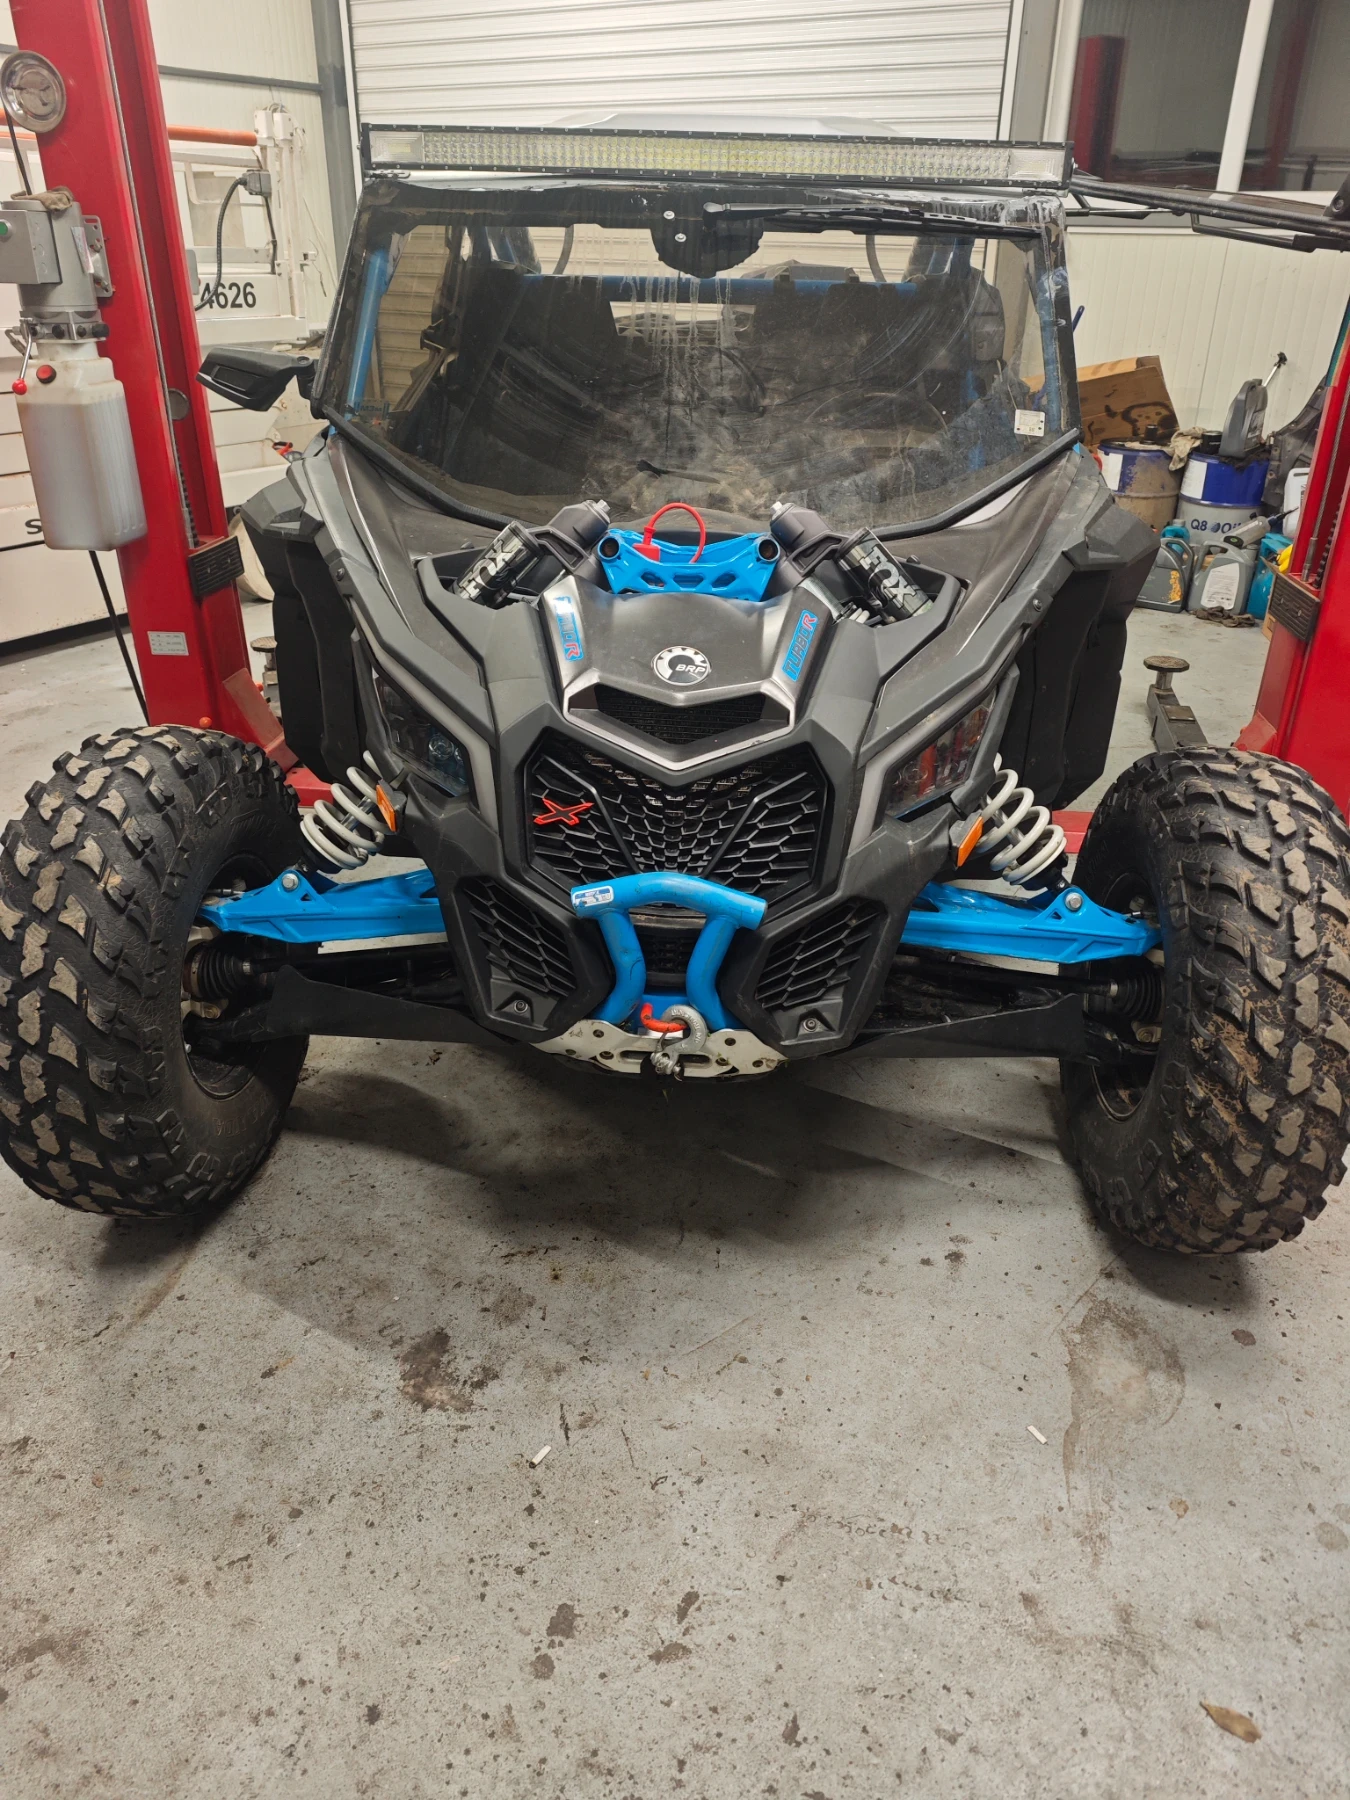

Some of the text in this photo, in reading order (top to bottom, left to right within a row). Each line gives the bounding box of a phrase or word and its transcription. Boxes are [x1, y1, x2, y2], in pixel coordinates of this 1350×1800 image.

[200, 281, 257, 309] 4626
[1190, 518, 1208, 531] Q8
[459, 539, 524, 600] FOX
[859, 545, 917, 610] FOX
[675, 663, 706, 674] BRP
